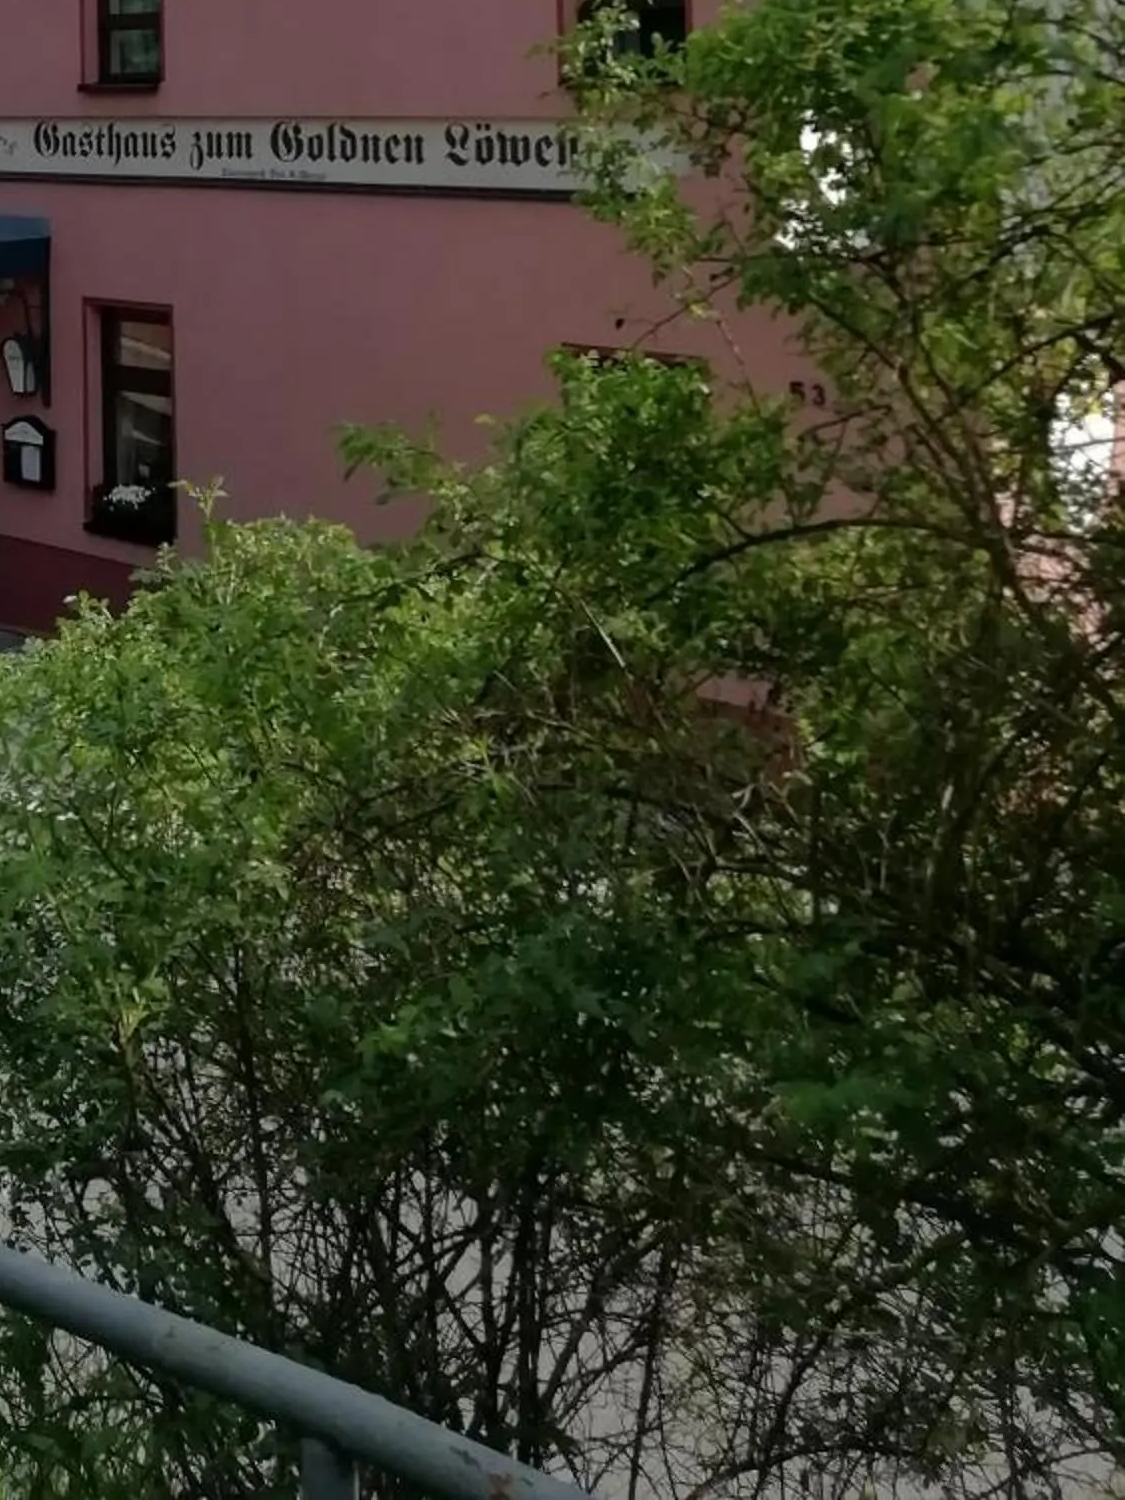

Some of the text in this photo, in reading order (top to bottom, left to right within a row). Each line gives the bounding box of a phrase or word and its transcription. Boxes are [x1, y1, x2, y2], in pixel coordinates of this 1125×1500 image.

[33, 120, 177, 168] Gasthaus
[189, 130, 253, 170] zum
[270, 120, 425, 165] Goldnen
